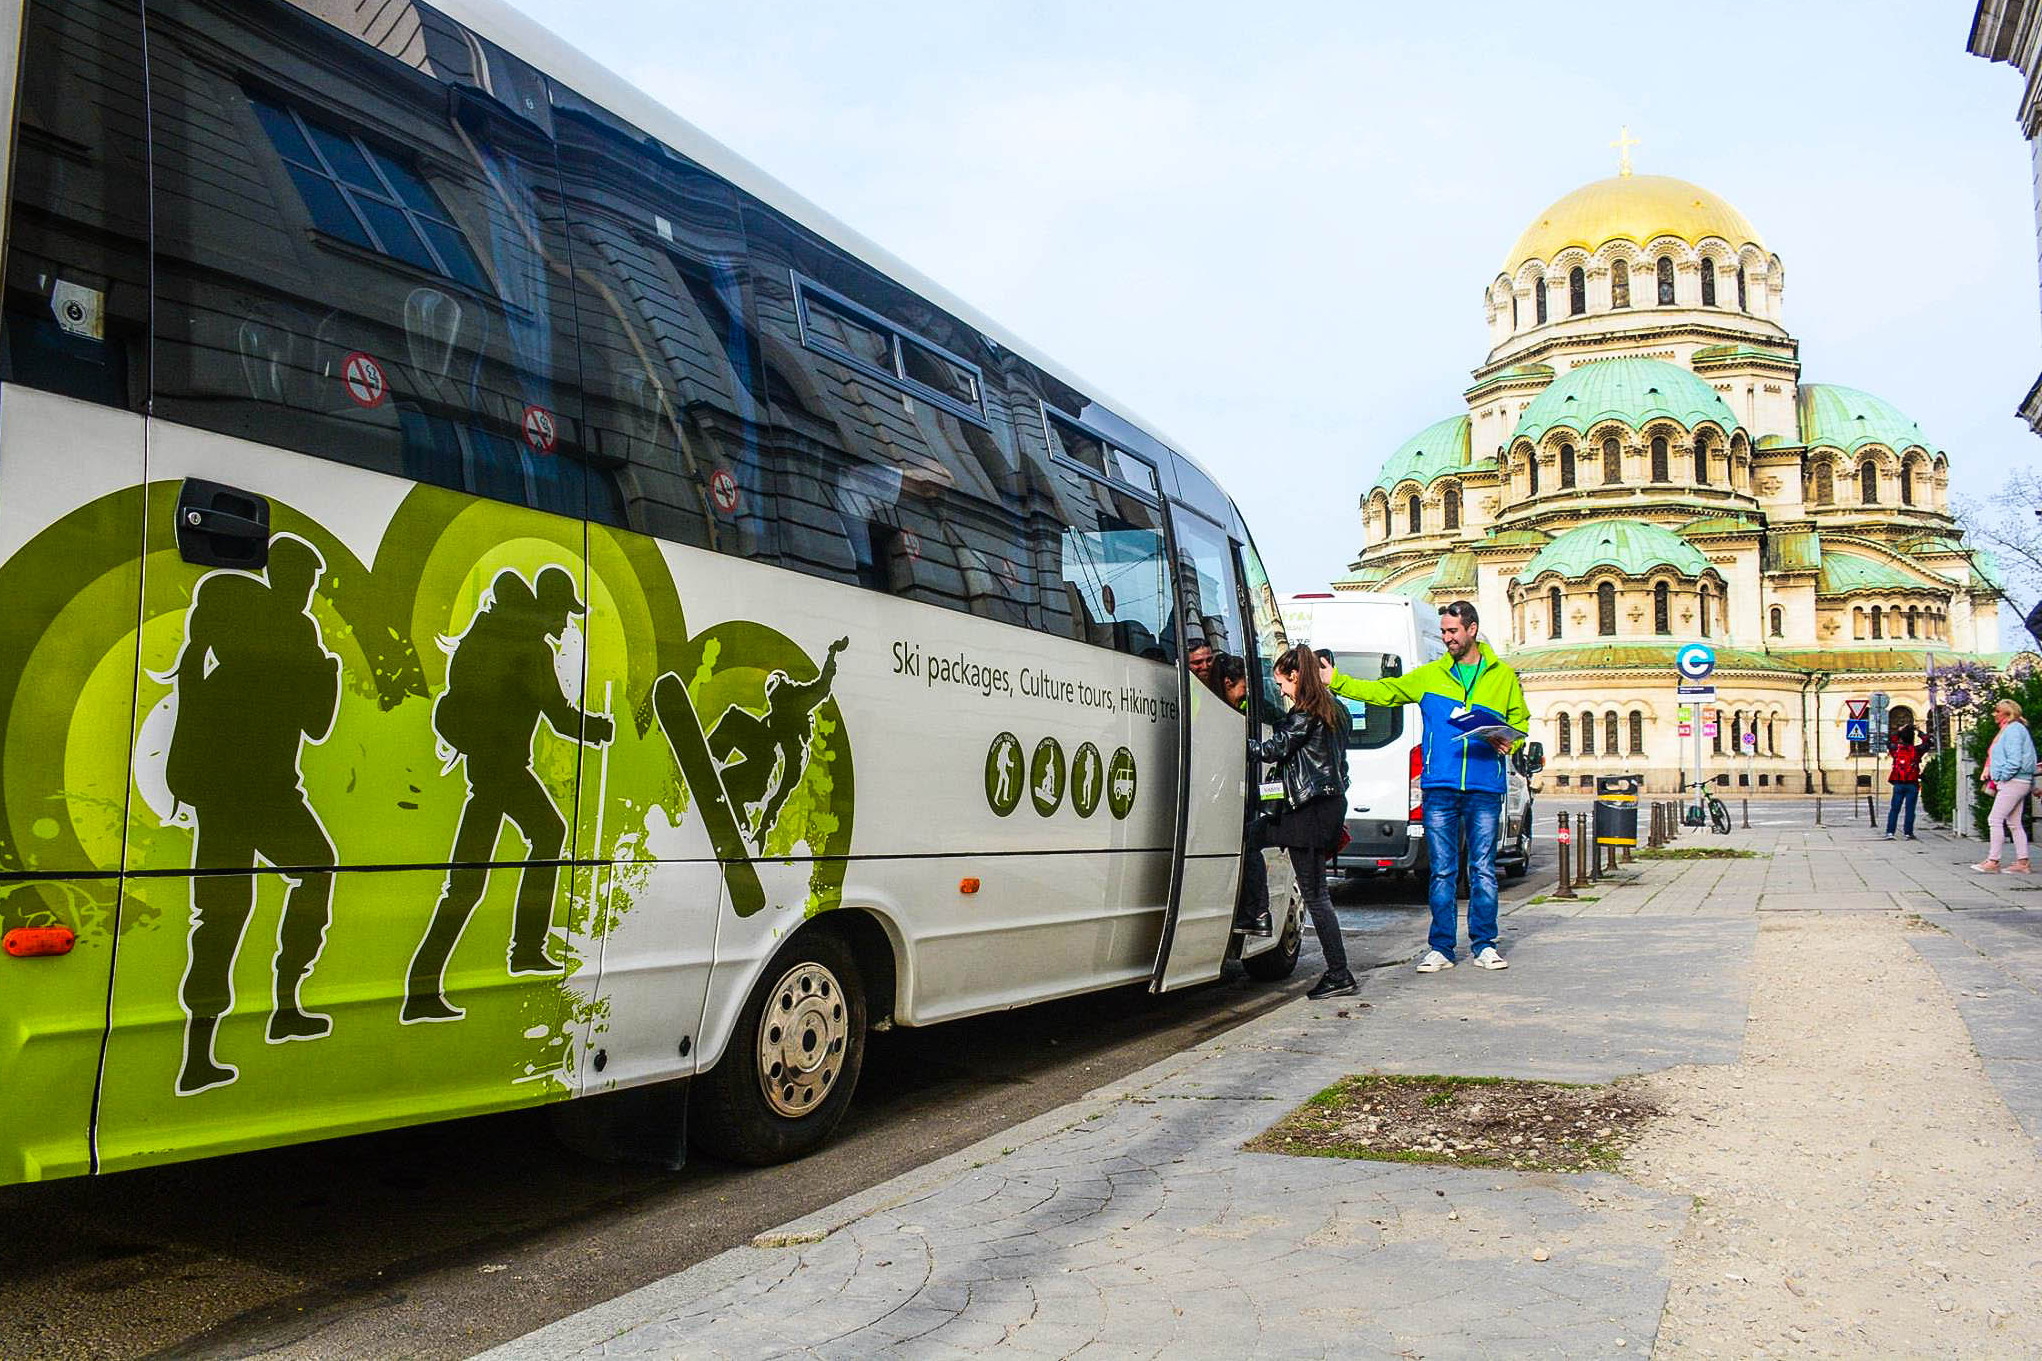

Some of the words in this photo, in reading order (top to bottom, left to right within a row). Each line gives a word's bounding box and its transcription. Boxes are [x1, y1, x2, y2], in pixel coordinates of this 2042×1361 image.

[892, 641, 920, 676] Ski
[928, 653, 1013, 698] packages,
[1019, 667, 1074, 703] Culture
[1077, 680, 1115, 714] tours,
[1120, 686, 1157, 723] Hiking
